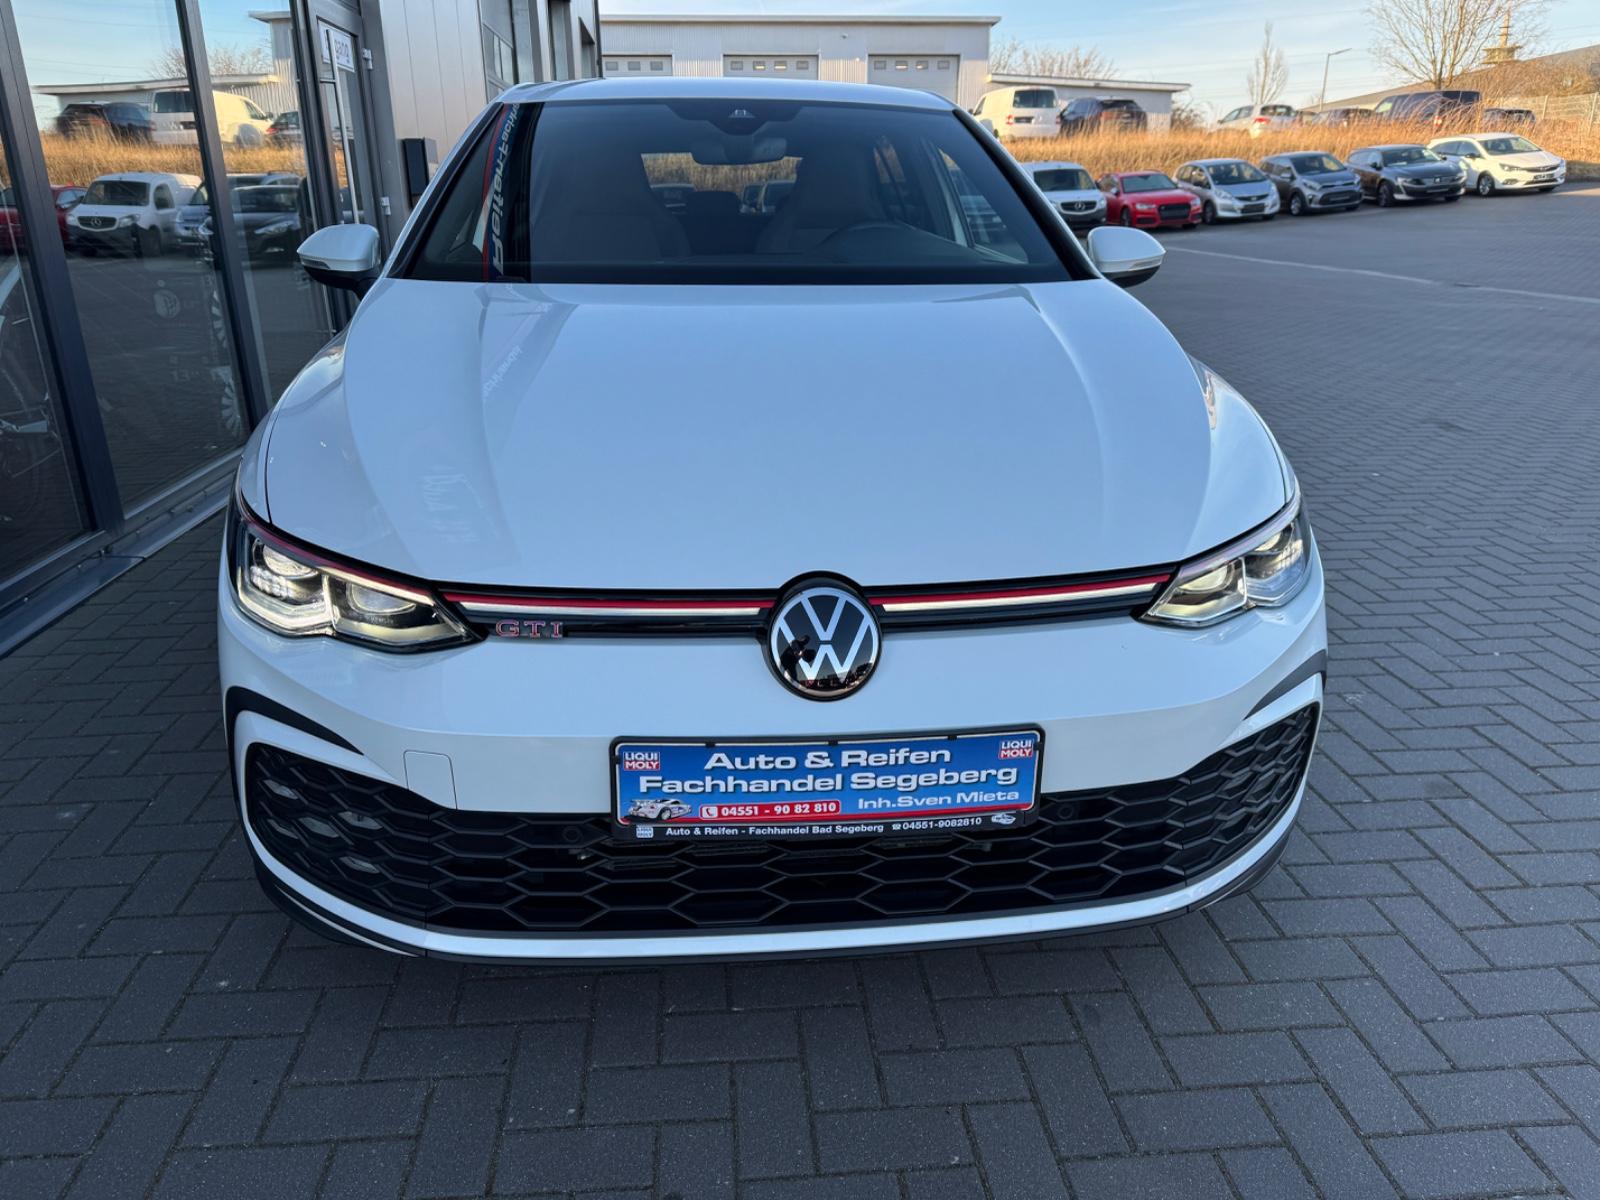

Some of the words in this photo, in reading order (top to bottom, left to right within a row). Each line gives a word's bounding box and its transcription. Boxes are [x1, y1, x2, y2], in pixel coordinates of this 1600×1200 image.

[495, 618, 563, 639] GTI
[1001, 740, 1033, 750] LIQUI
[625, 752, 658, 761] LIQUI
[704, 752, 796, 770] Auto
[804, 751, 834, 768] &
[841, 747, 951, 767] Reifen
[1000, 749, 1032, 758] MOLY
[625, 761, 659, 770] MOLY
[639, 773, 842, 793] Fachhandel
[851, 767, 1018, 791] Segeberg
[956, 791, 1020, 804] Mieta
[721, 806, 759, 817] 04551
[774, 804, 790, 815] 90
[794, 803, 810, 814] 82
[814, 802, 837, 813] 810
[666, 827, 691, 835] Auto
[694, 827, 702, 835] &
[705, 827, 738, 835] Reifen
[749, 826, 809, 835] Fachhandel
[812, 825, 832, 834] Bad
[835, 824, 884, 833] Segeberg
[902, 818, 982, 830] 04551-9082810
